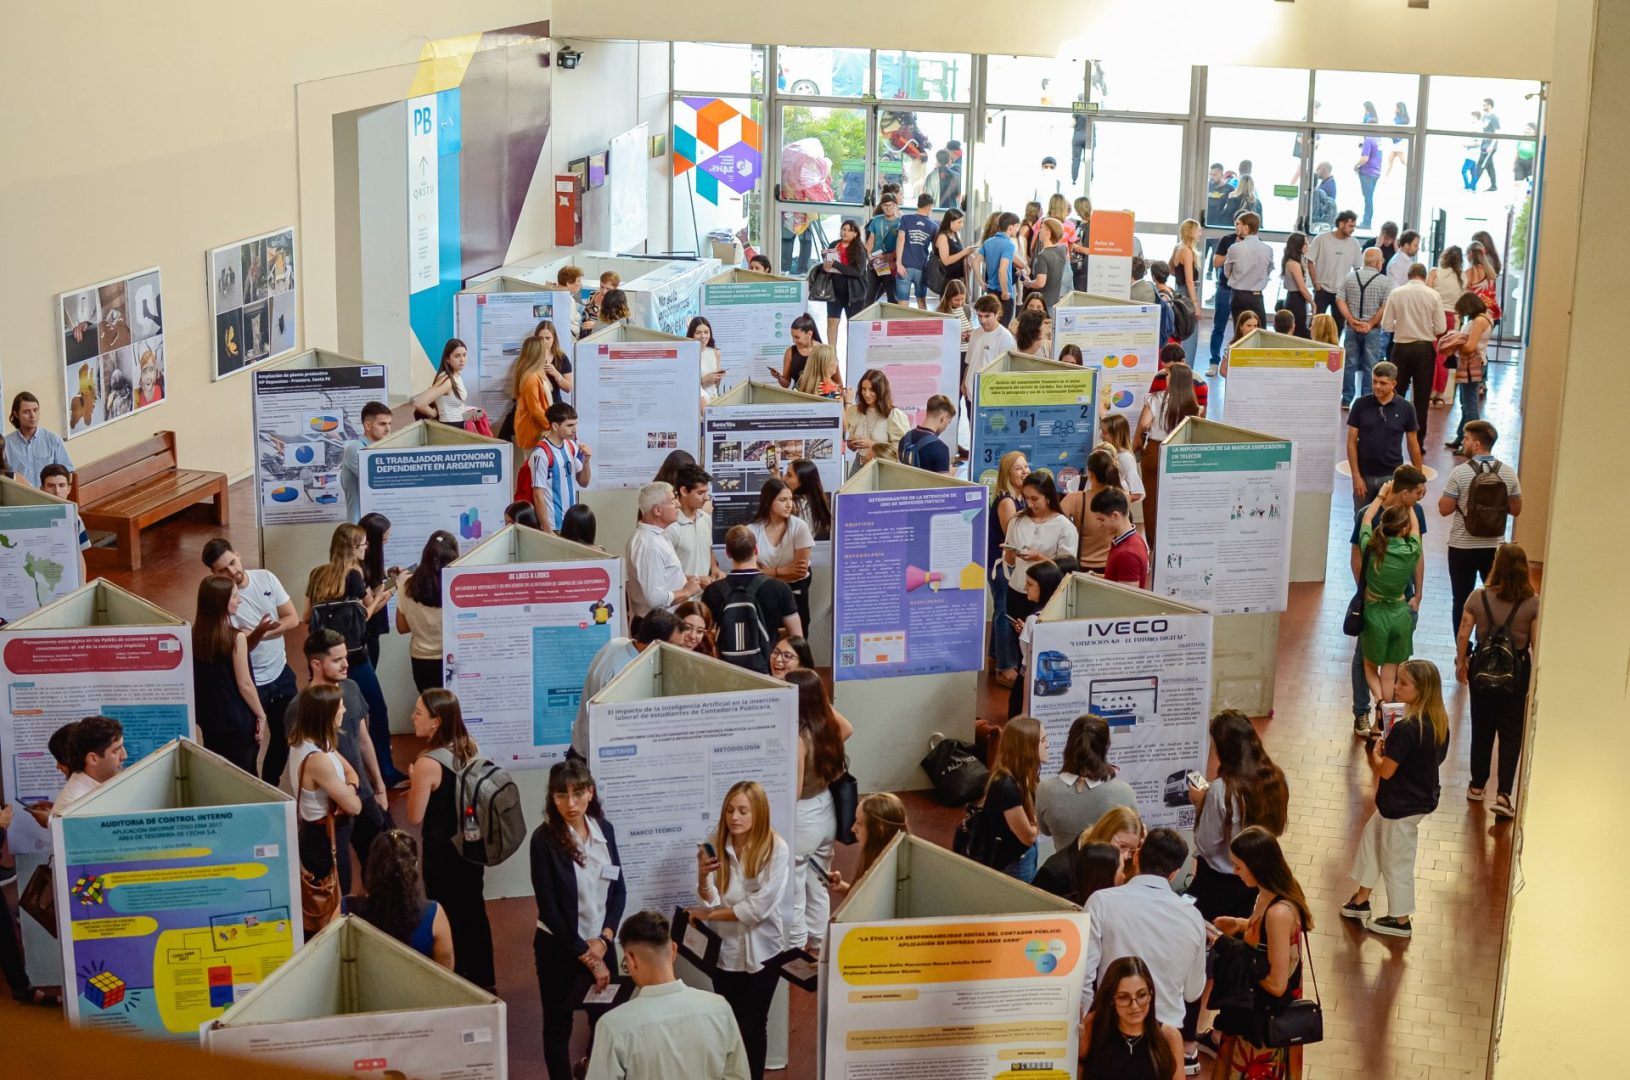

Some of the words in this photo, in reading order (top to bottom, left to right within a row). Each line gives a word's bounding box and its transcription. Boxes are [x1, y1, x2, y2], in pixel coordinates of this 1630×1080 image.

[414, 106, 431, 135] PB
[1080, 405, 1088, 418] 2
[1030, 413, 1035, 427] 1
[386, 455, 443, 465] TRABAJADOR
[984, 449, 993, 463] 3
[376, 463, 433, 472] DEPENDIENTE
[446, 462, 495, 470] ARGENTINA
[1087, 619, 1168, 637] IVECO
[615, 707, 643, 715] impacto
[662, 703, 700, 712] Inteligencia
[702, 701, 730, 709] Artificial
[750, 697, 780, 705] inserción
[650, 710, 690, 718] estudiantes
[700, 706, 738, 714] Contador/a
[739, 704, 771, 712] Público/a
[600, 746, 636, 756] OBJETIVOS
[713, 744, 761, 753] METODOLOGÍA
[101, 818, 144, 828] AUDITORIA
[146, 817, 156, 825] DE
[158, 815, 196, 824] CONTROL
[197, 812, 233, 822] INTERNO
[112, 827, 147, 835] APLICACIÓN
[630, 828, 653, 836] MARCO
[655, 825, 682, 835] TEÓRICO
